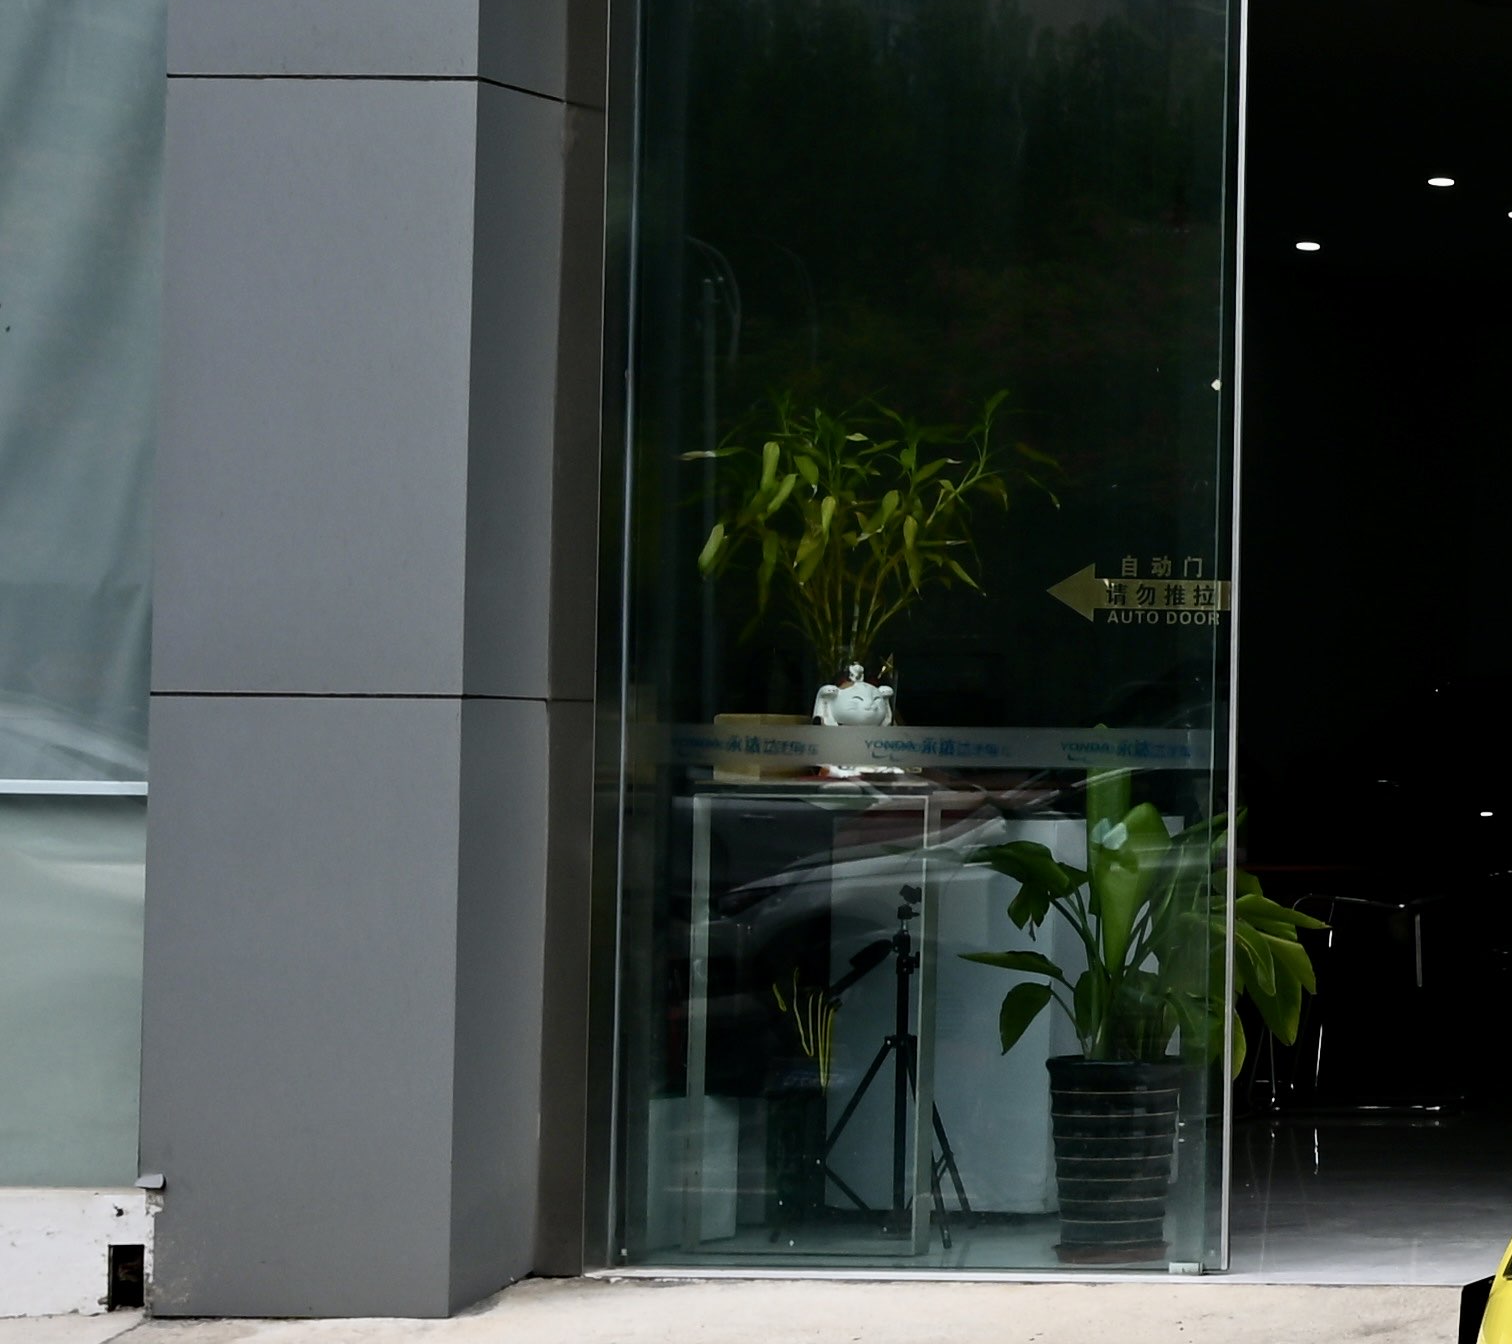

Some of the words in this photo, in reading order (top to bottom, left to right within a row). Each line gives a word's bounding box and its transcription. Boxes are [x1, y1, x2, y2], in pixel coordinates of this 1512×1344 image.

[1121, 556, 1203, 578] 自动门
[1106, 583, 1215, 607] 请勿推拉
[1107, 610, 1159, 624] AUTO
[1166, 611, 1220, 625] DOOR
[865, 739, 916, 751] YONDA
